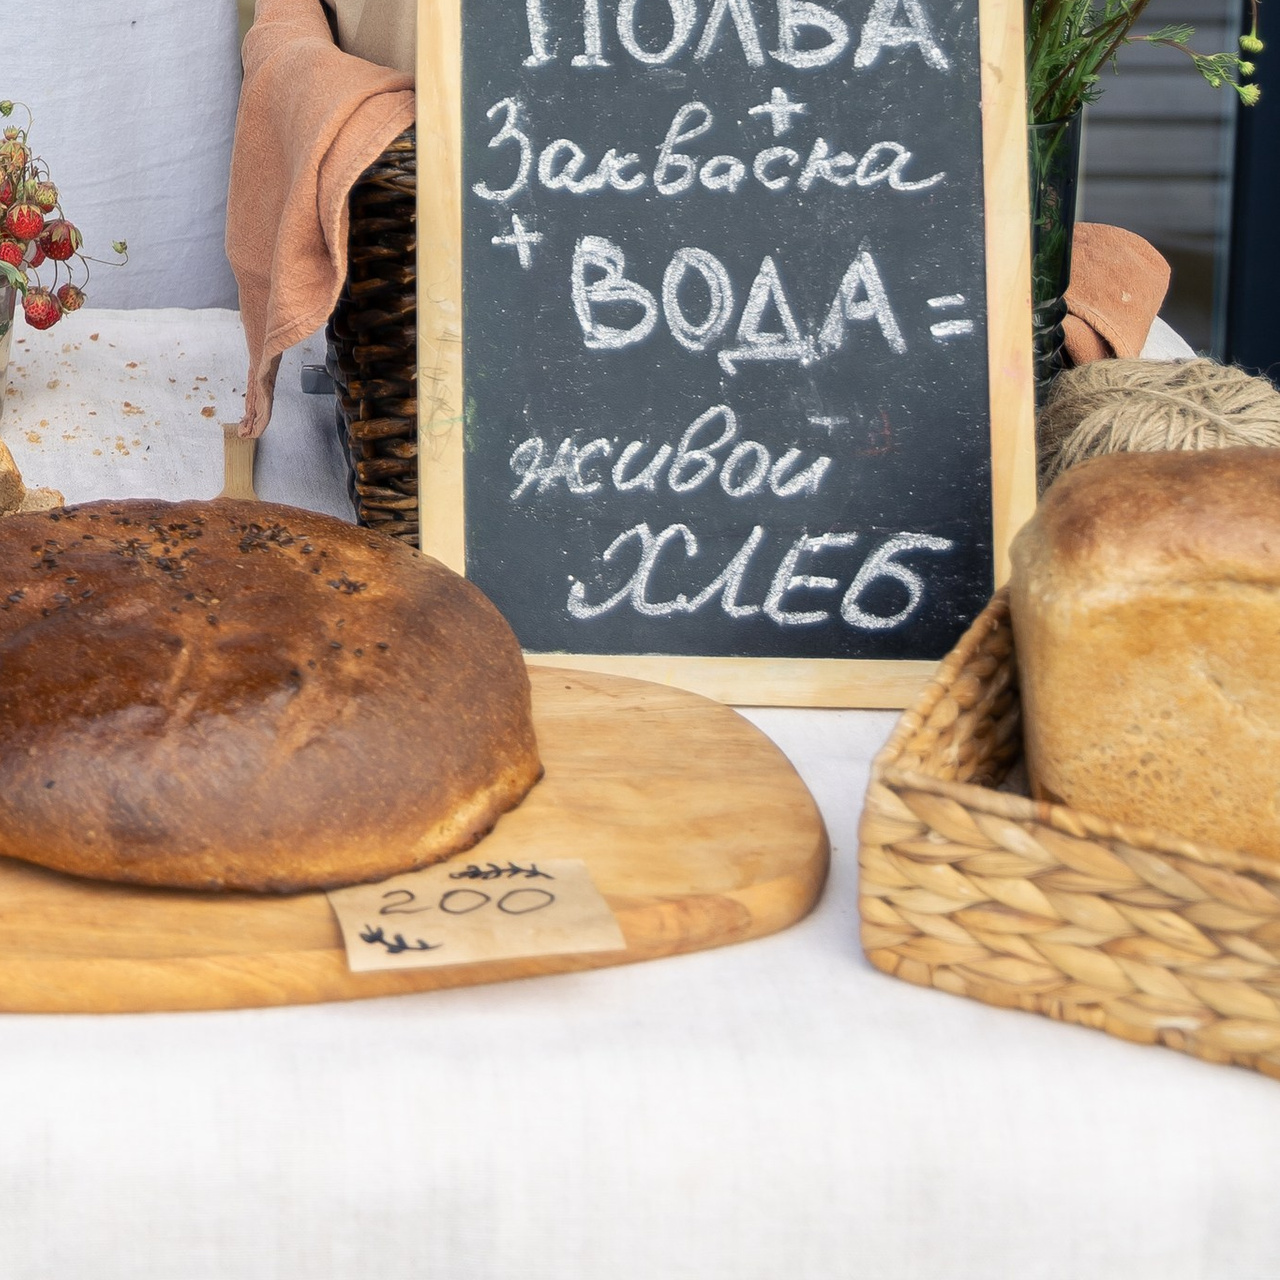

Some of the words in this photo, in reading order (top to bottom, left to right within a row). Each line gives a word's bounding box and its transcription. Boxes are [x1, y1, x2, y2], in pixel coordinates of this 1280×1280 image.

[472, 96, 946, 202] Закваска
[570, 235, 907, 375] ВОДА
[567, 522, 954, 630] ХЛЕБ
[379, 888, 556, 916] 200
